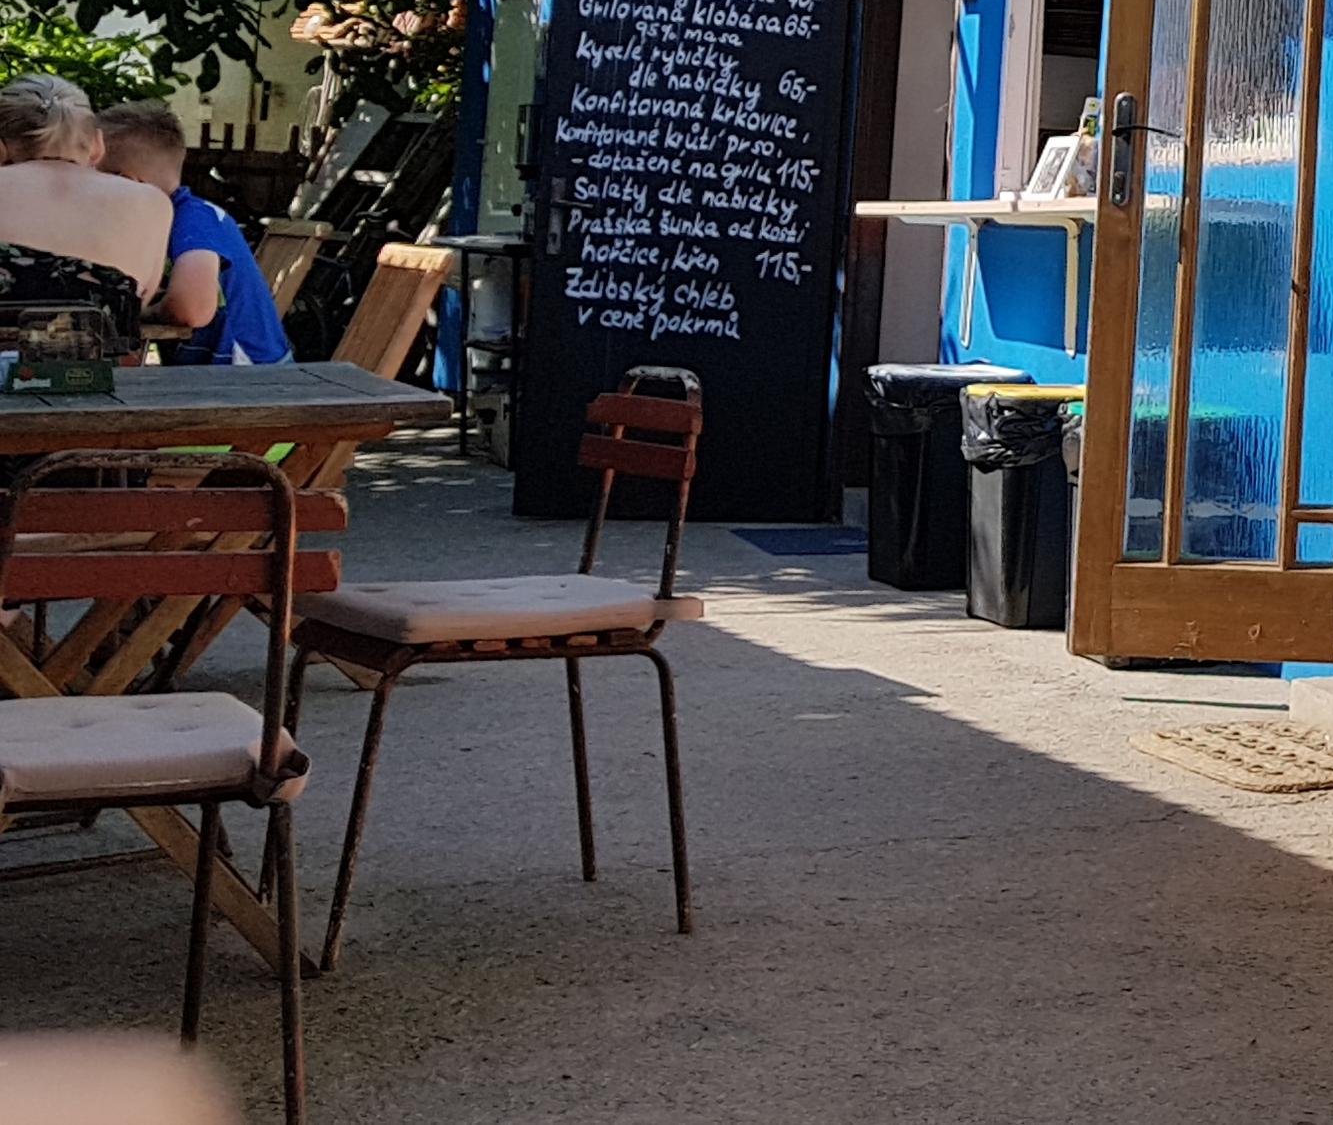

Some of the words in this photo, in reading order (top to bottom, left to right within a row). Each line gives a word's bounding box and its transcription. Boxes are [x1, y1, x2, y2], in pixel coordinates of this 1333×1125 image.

[684, 27, 744, 47] masa
[629, 63, 659, 88] dle
[658, 180, 693, 205] dle
[727, 218, 755, 241] od
